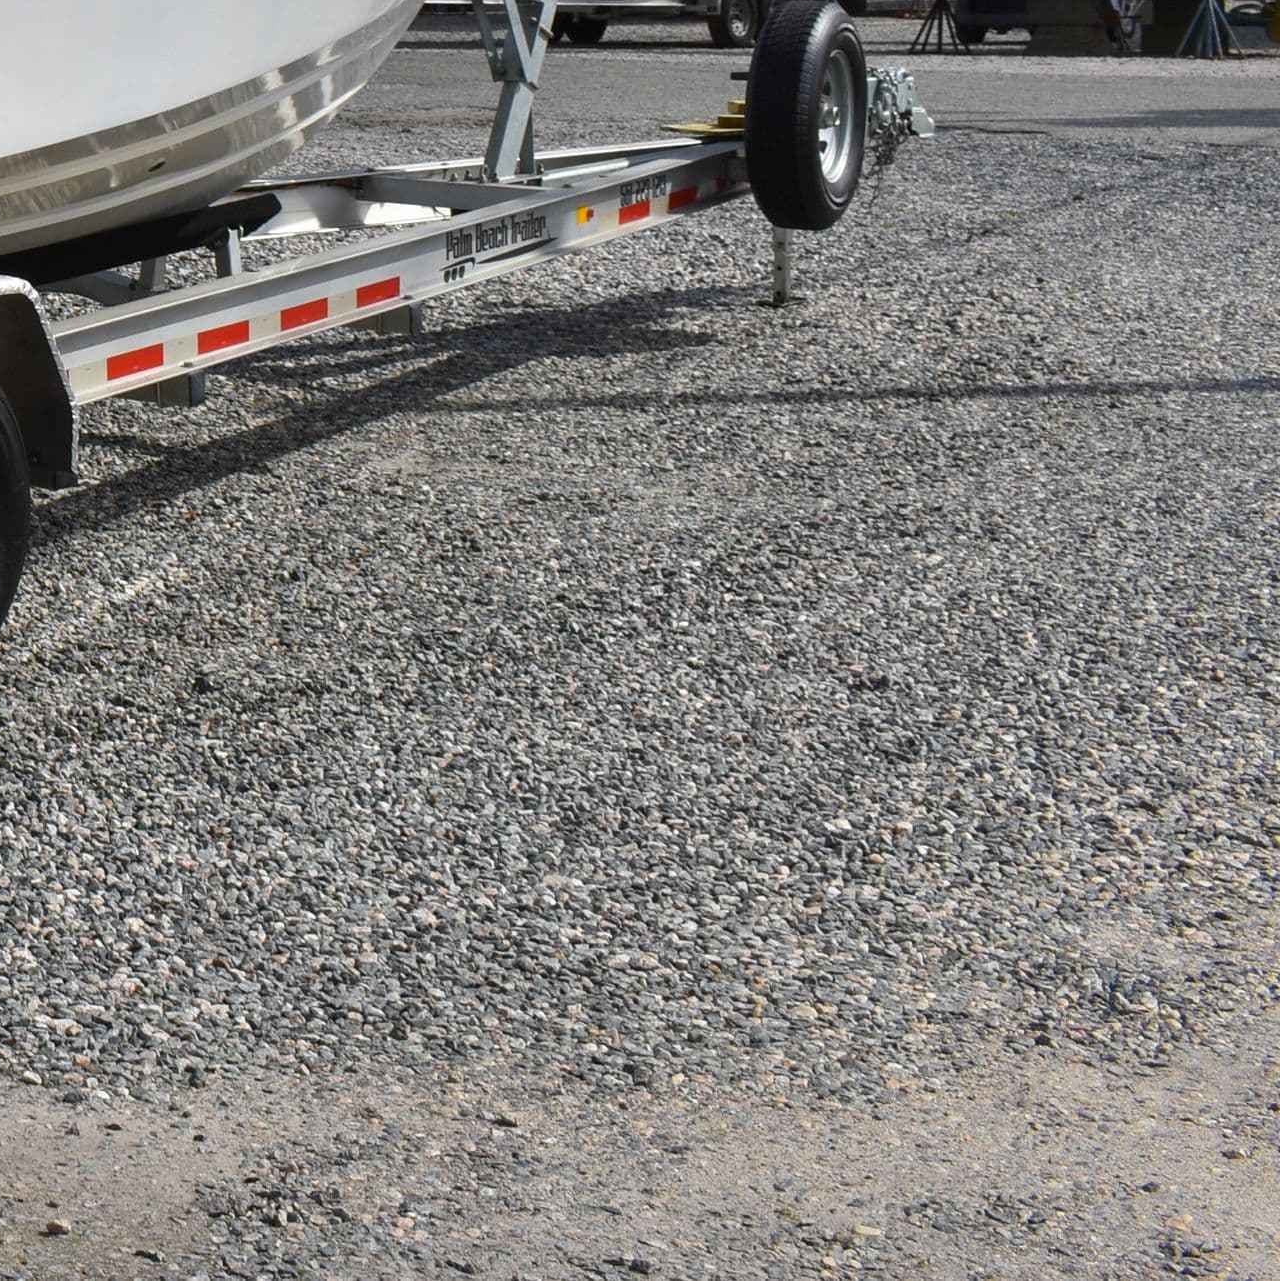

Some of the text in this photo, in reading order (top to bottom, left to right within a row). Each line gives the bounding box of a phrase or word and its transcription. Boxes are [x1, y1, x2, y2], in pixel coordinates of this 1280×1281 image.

[445, 212, 547, 261] Palm Beach Trailer
